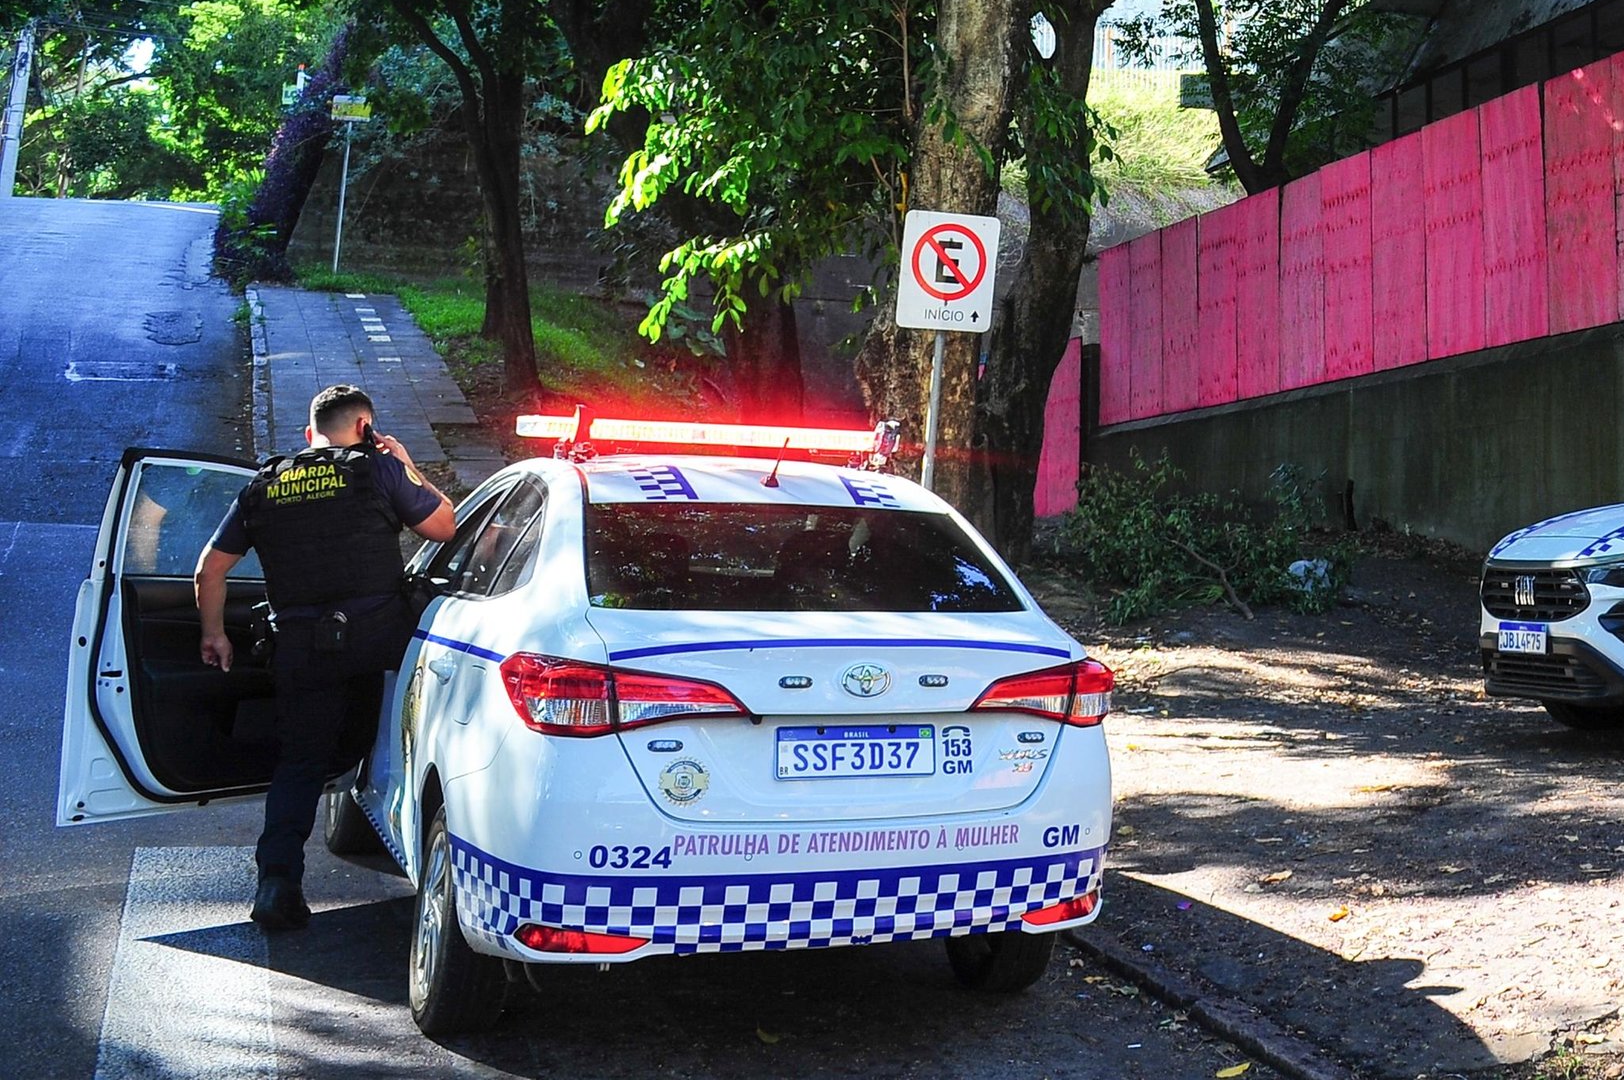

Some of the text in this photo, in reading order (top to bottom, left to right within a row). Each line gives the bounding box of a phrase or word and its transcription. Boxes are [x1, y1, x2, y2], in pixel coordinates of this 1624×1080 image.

[935, 239, 964, 284] E
[924, 307, 964, 322] INÍCIO
[280, 464, 336, 483] GUARDA
[266, 474, 347, 499] MUNICIPAL
[306, 490, 336, 501] ALEGRE
[843, 731, 870, 739] BRASIL
[793, 742, 920, 771] SSF3D37
[942, 738, 972, 758] 153
[942, 759, 973, 775] GM
[673, 823, 1020, 857] PATRULHA DE ATENDIMENTO À MULHER
[1042, 823, 1081, 848] GM
[589, 844, 673, 869] 0324
